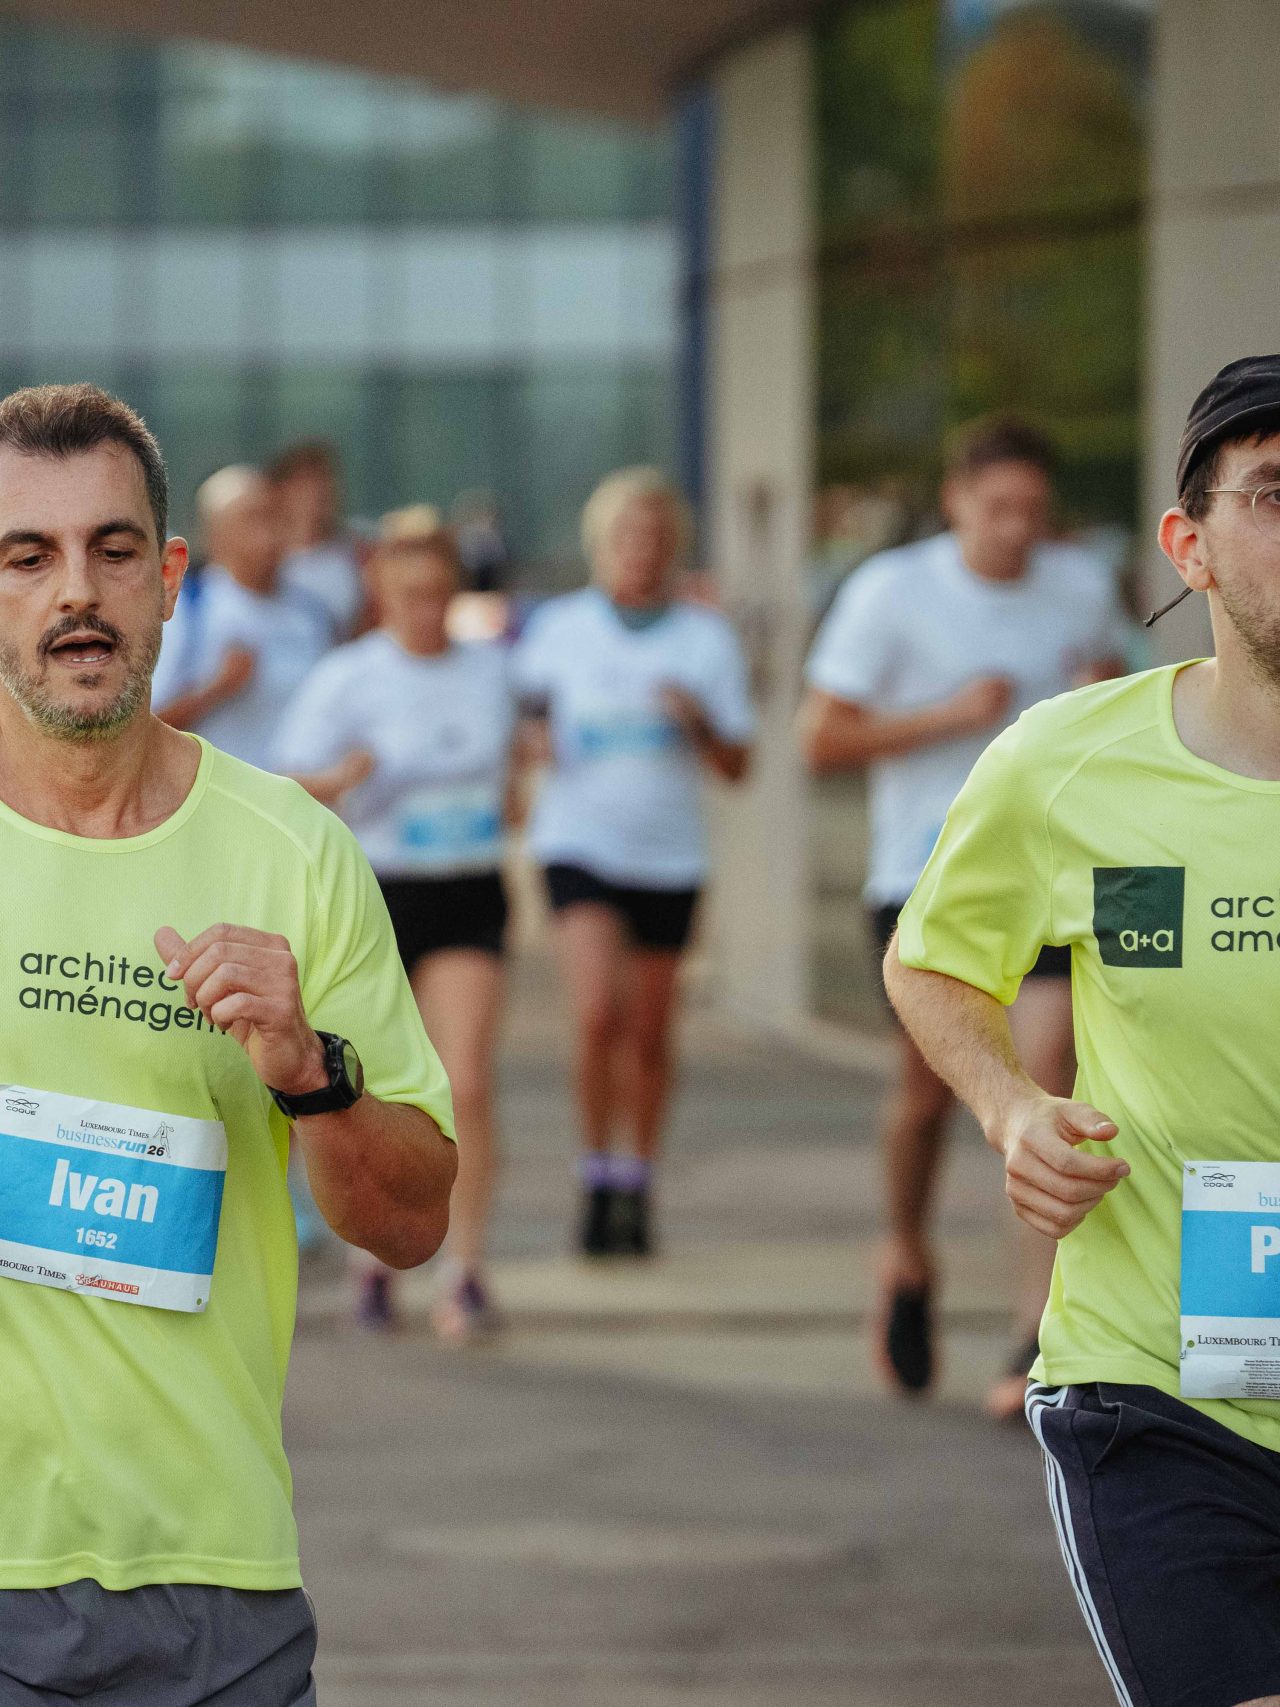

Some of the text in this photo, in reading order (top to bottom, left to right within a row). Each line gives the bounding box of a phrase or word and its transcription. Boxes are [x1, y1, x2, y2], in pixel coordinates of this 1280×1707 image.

[1211, 888, 1280, 918] arc
[1119, 929, 1174, 952] a+a
[1211, 930, 1280, 952] am
[6, 1105, 36, 1116] COQUE
[48, 1158, 159, 1223] Ivan
[1258, 1191, 1280, 1207] bu
[76, 1227, 118, 1250] 1652
